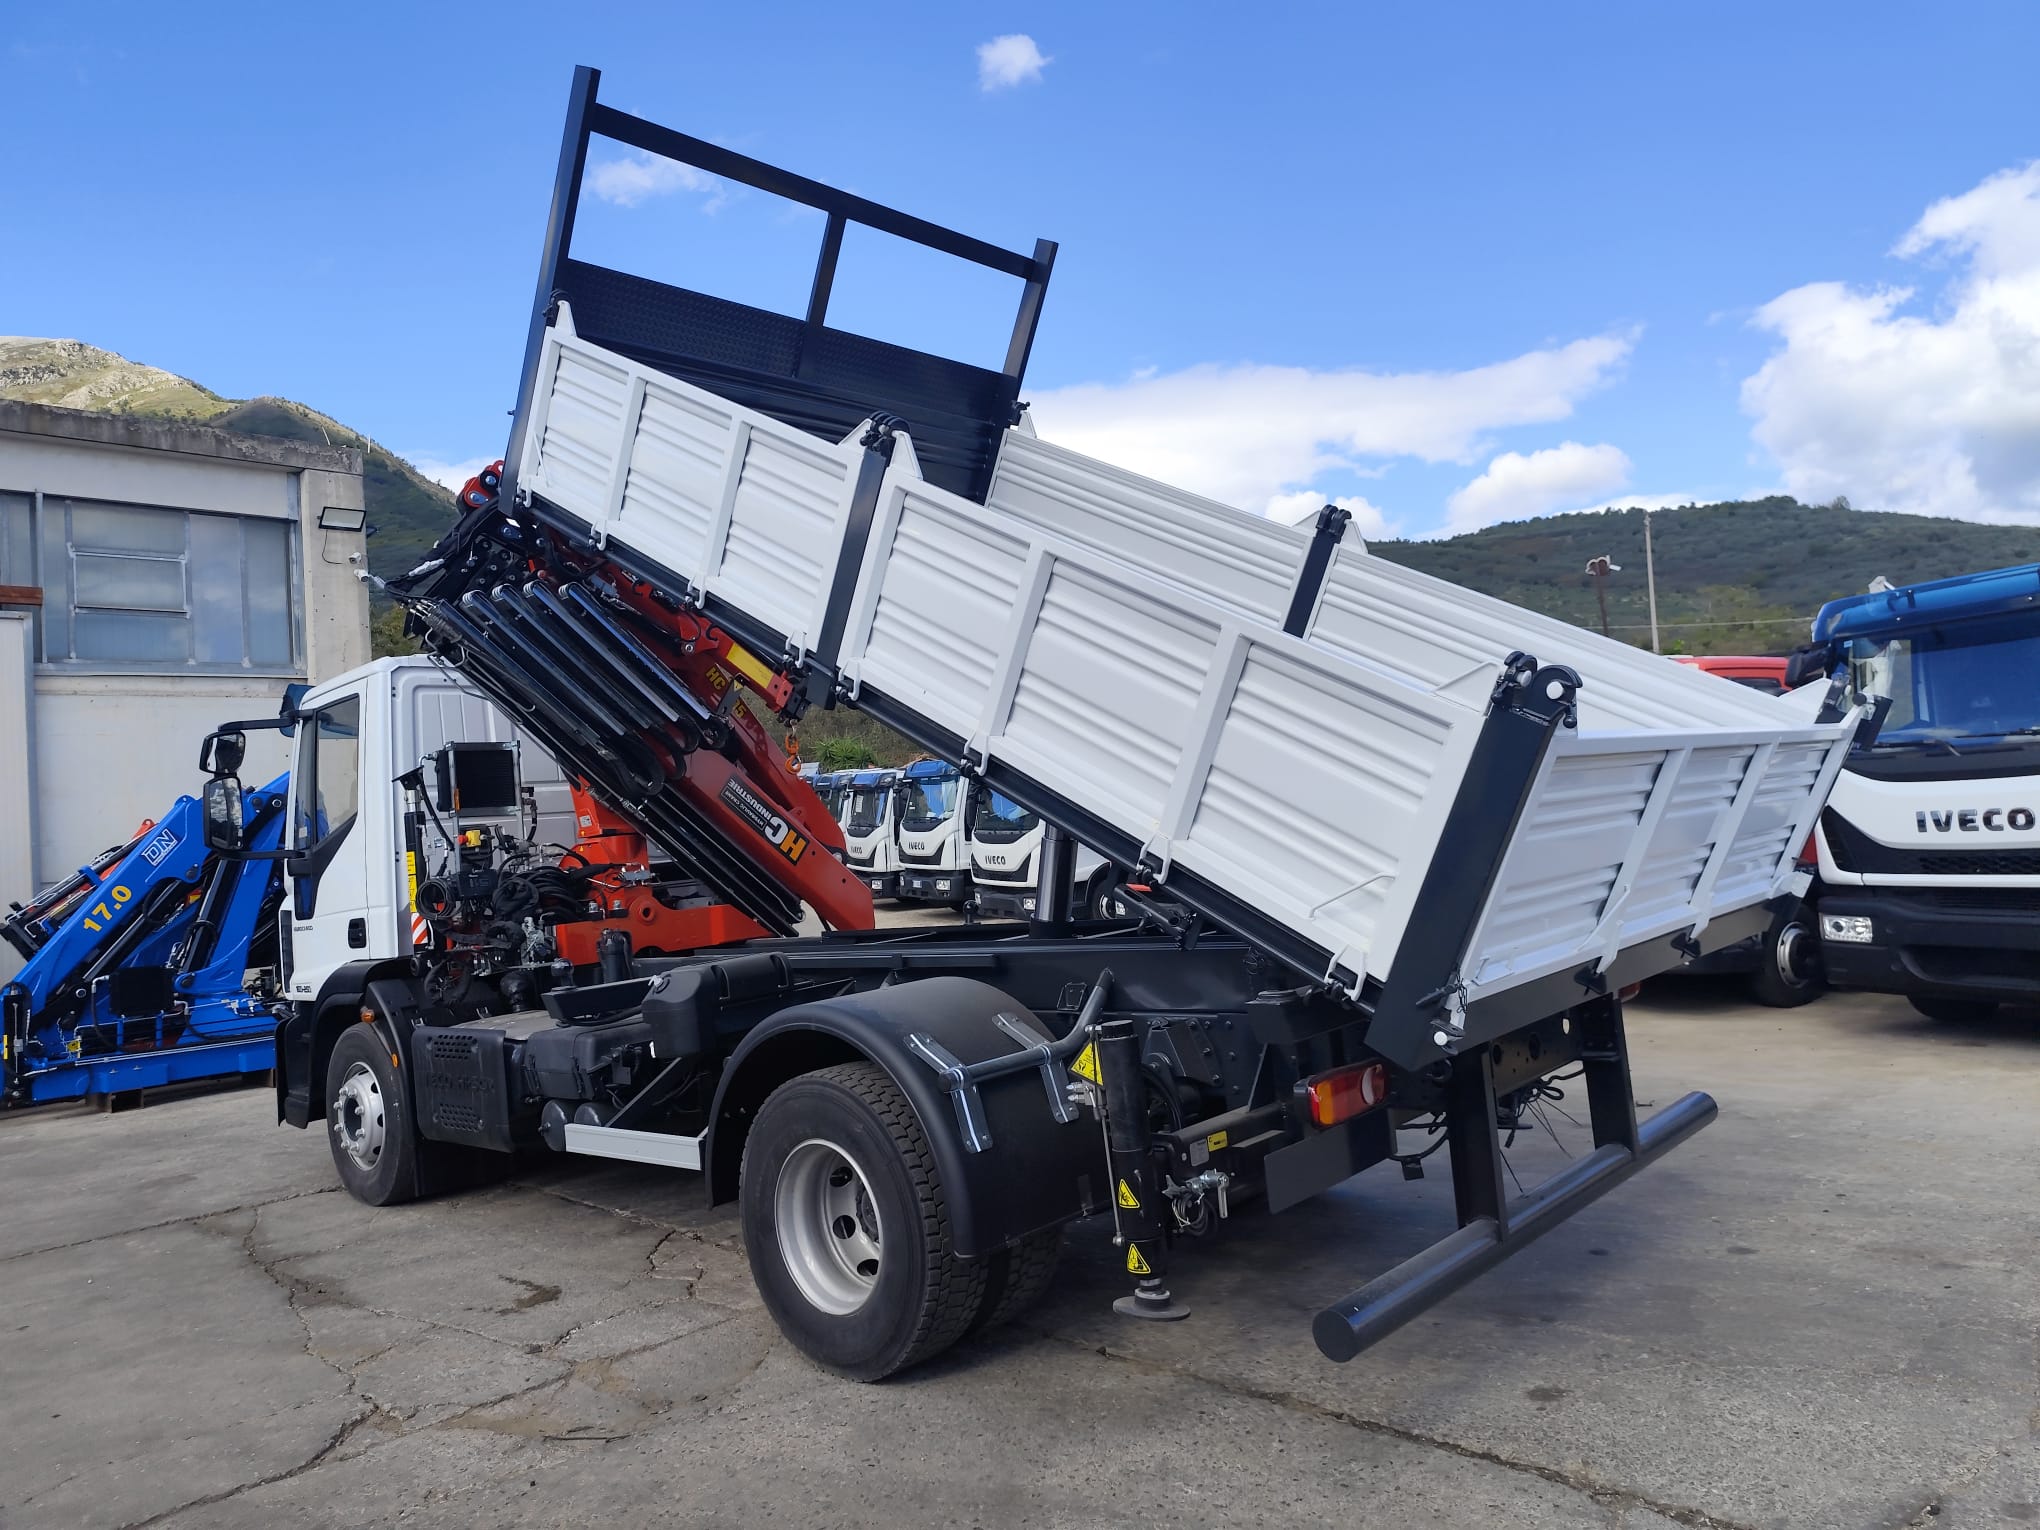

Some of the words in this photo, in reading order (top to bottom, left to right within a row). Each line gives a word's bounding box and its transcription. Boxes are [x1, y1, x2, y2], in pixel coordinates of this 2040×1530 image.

[706, 667, 726, 690] HC
[727, 779, 772, 820] INDUSTRIE
[1915, 807, 2036, 833] IVECO
[142, 829, 178, 866] DN
[764, 816, 807, 861] HC
[850, 846, 863, 854] IVECO
[908, 841, 925, 850] IVECO
[984, 855, 1006, 866] IVECO
[83, 885, 132, 932] 17.0
